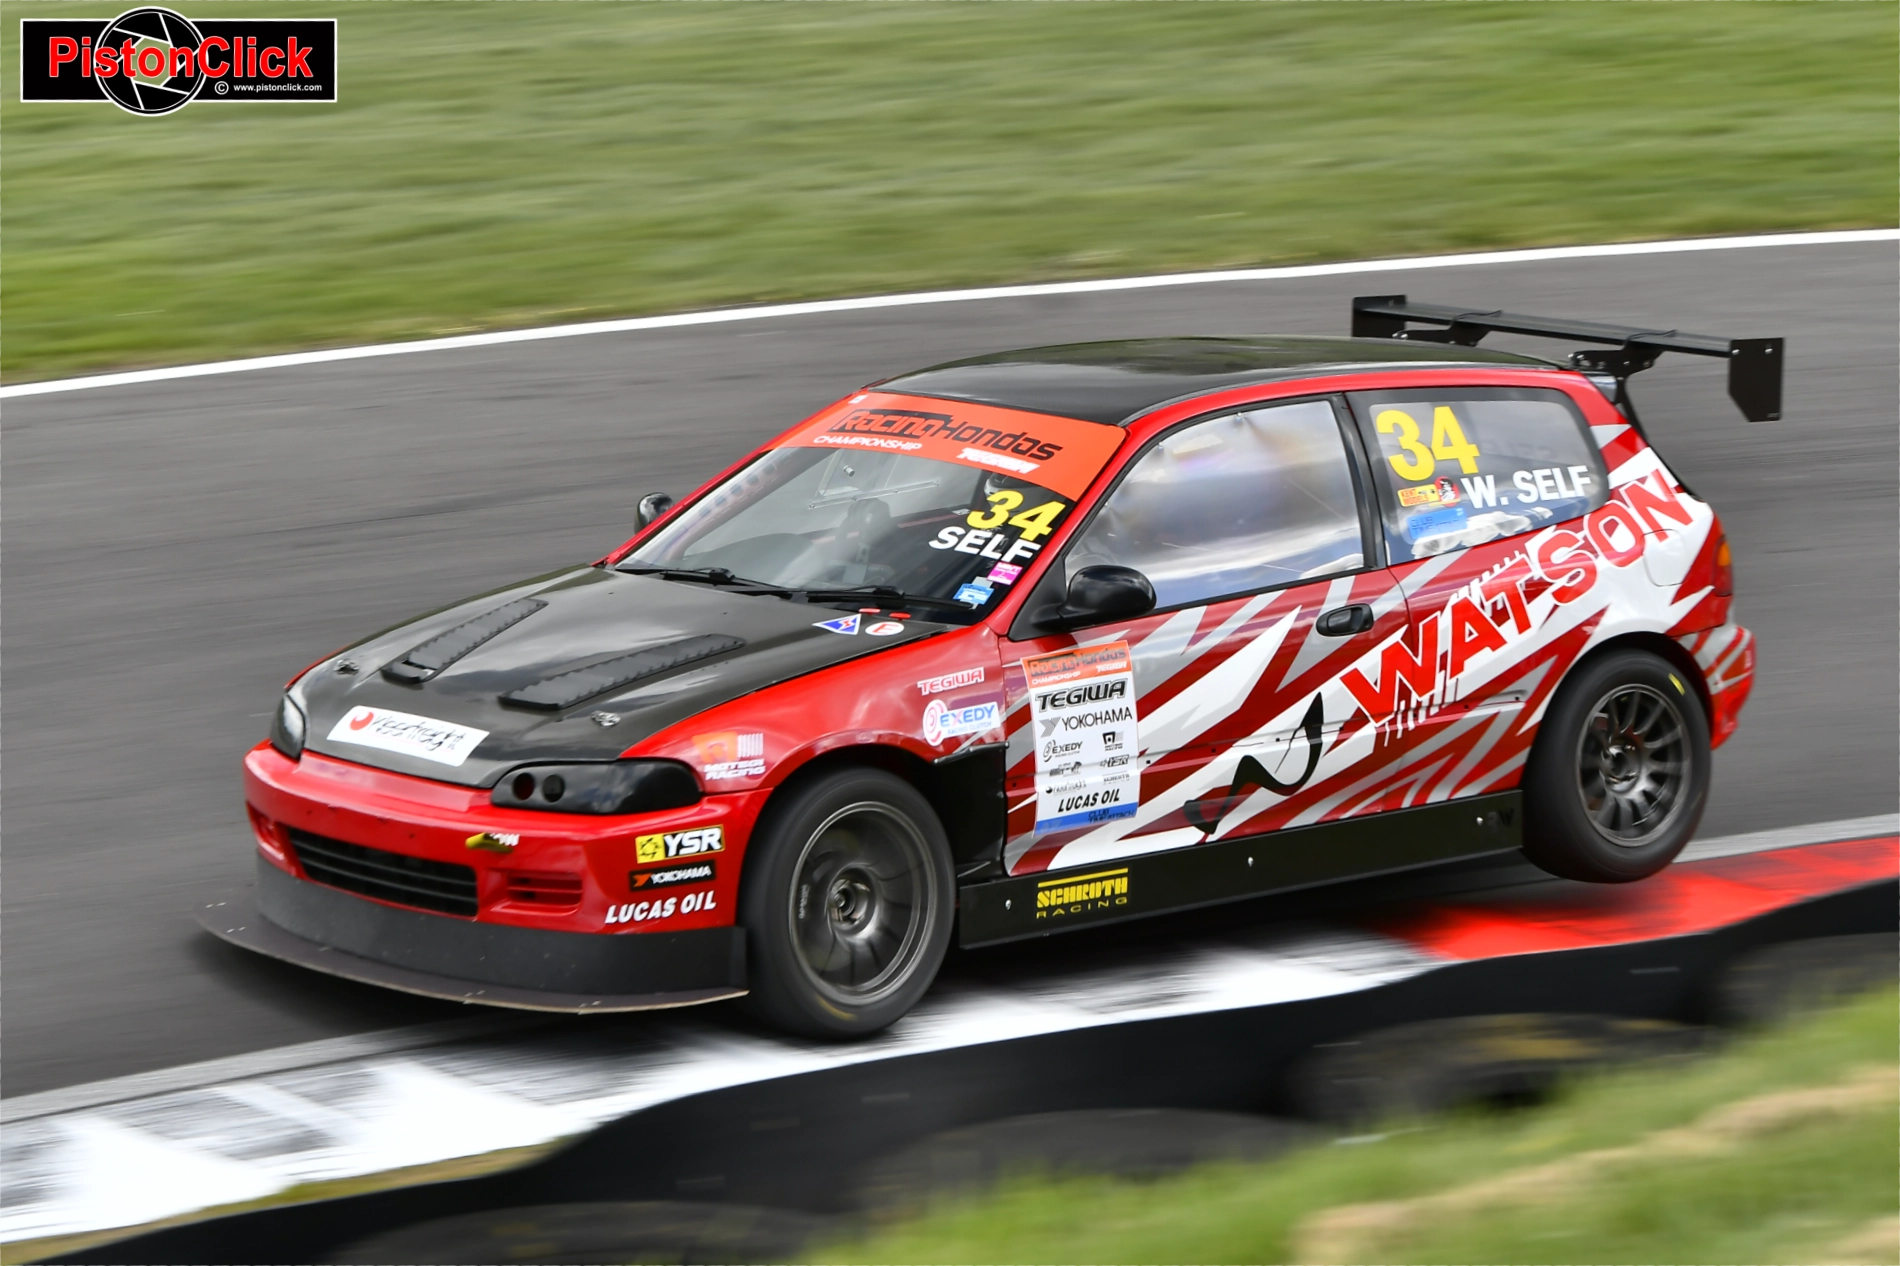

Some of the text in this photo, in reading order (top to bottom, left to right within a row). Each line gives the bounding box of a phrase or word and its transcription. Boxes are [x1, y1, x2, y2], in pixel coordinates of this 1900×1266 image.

[813, 435, 923, 451] CHAMPIONSHIP
[1376, 406, 1480, 481] 34
[1461, 465, 1591, 508] W. SELF
[966, 490, 1067, 542] 34
[928, 526, 1041, 562] SELF
[1340, 469, 1694, 726] WATSON
[918, 667, 984, 695] TEGIWA
[1036, 679, 1127, 712] TEGIWA
[940, 704, 995, 727] EXEDY
[1062, 706, 1132, 731] YOKOHAMA
[1052, 741, 1083, 754] EXEDY
[705, 766, 765, 781] RACING
[1058, 788, 1120, 813] LUCAS OIL
[664, 827, 721, 857] YSR
[651, 865, 711, 884] YOKOHAMA
[605, 890, 717, 924] LUCAS OIL
[1037, 877, 1128, 908] SCHROTH
[1036, 897, 1128, 919] RACING
